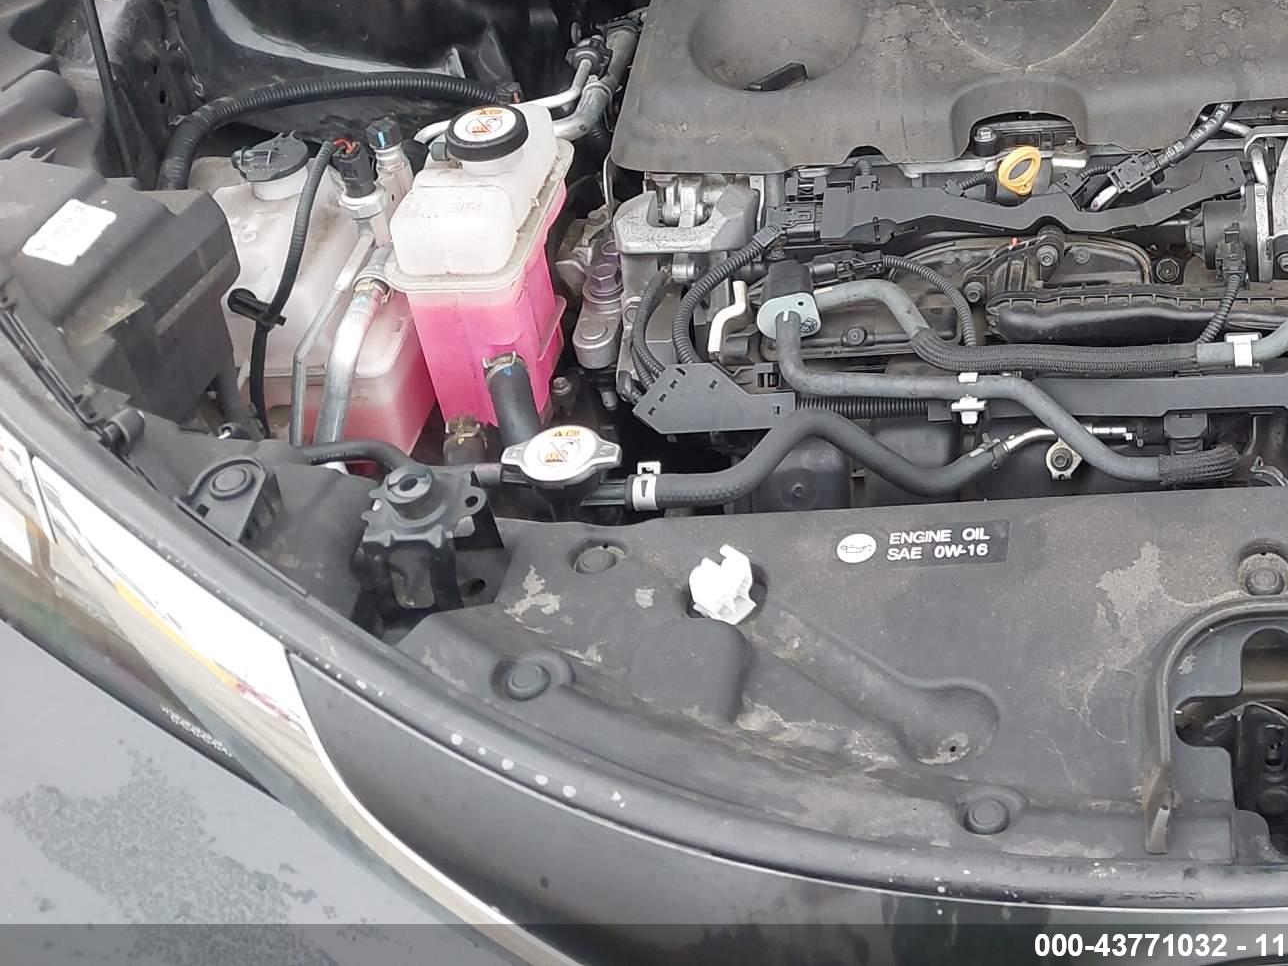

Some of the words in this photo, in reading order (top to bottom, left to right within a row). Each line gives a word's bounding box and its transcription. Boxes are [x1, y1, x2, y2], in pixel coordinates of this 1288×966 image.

[889, 529, 952, 545] ENGINE
[961, 527, 990, 542] OIL
[886, 546, 923, 561] SAE
[933, 543, 989, 559] 0W-16
